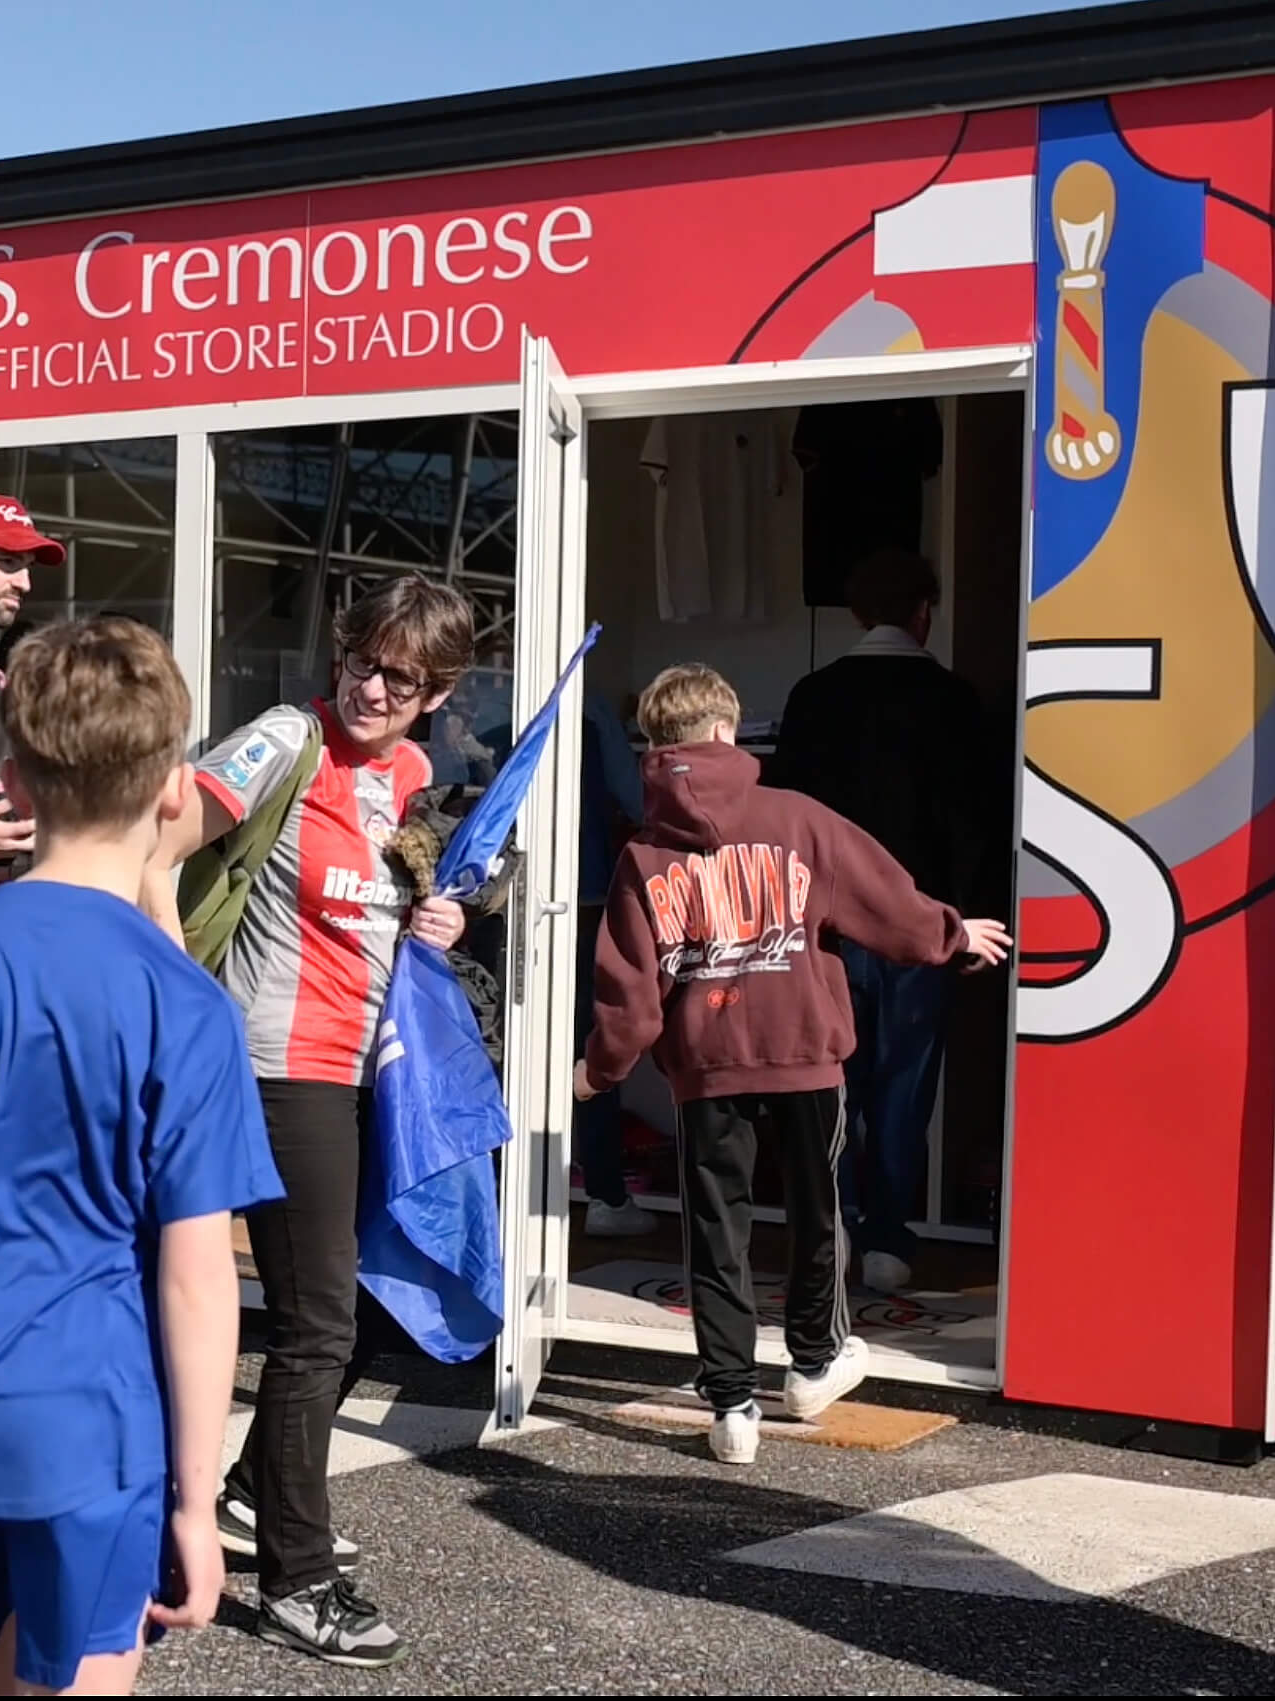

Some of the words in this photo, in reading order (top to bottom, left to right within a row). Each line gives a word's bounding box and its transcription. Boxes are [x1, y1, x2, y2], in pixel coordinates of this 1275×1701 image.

[74, 204, 594, 320] Cremonese
[153, 321, 299, 379] STORE
[311, 302, 504, 365] STADIO
